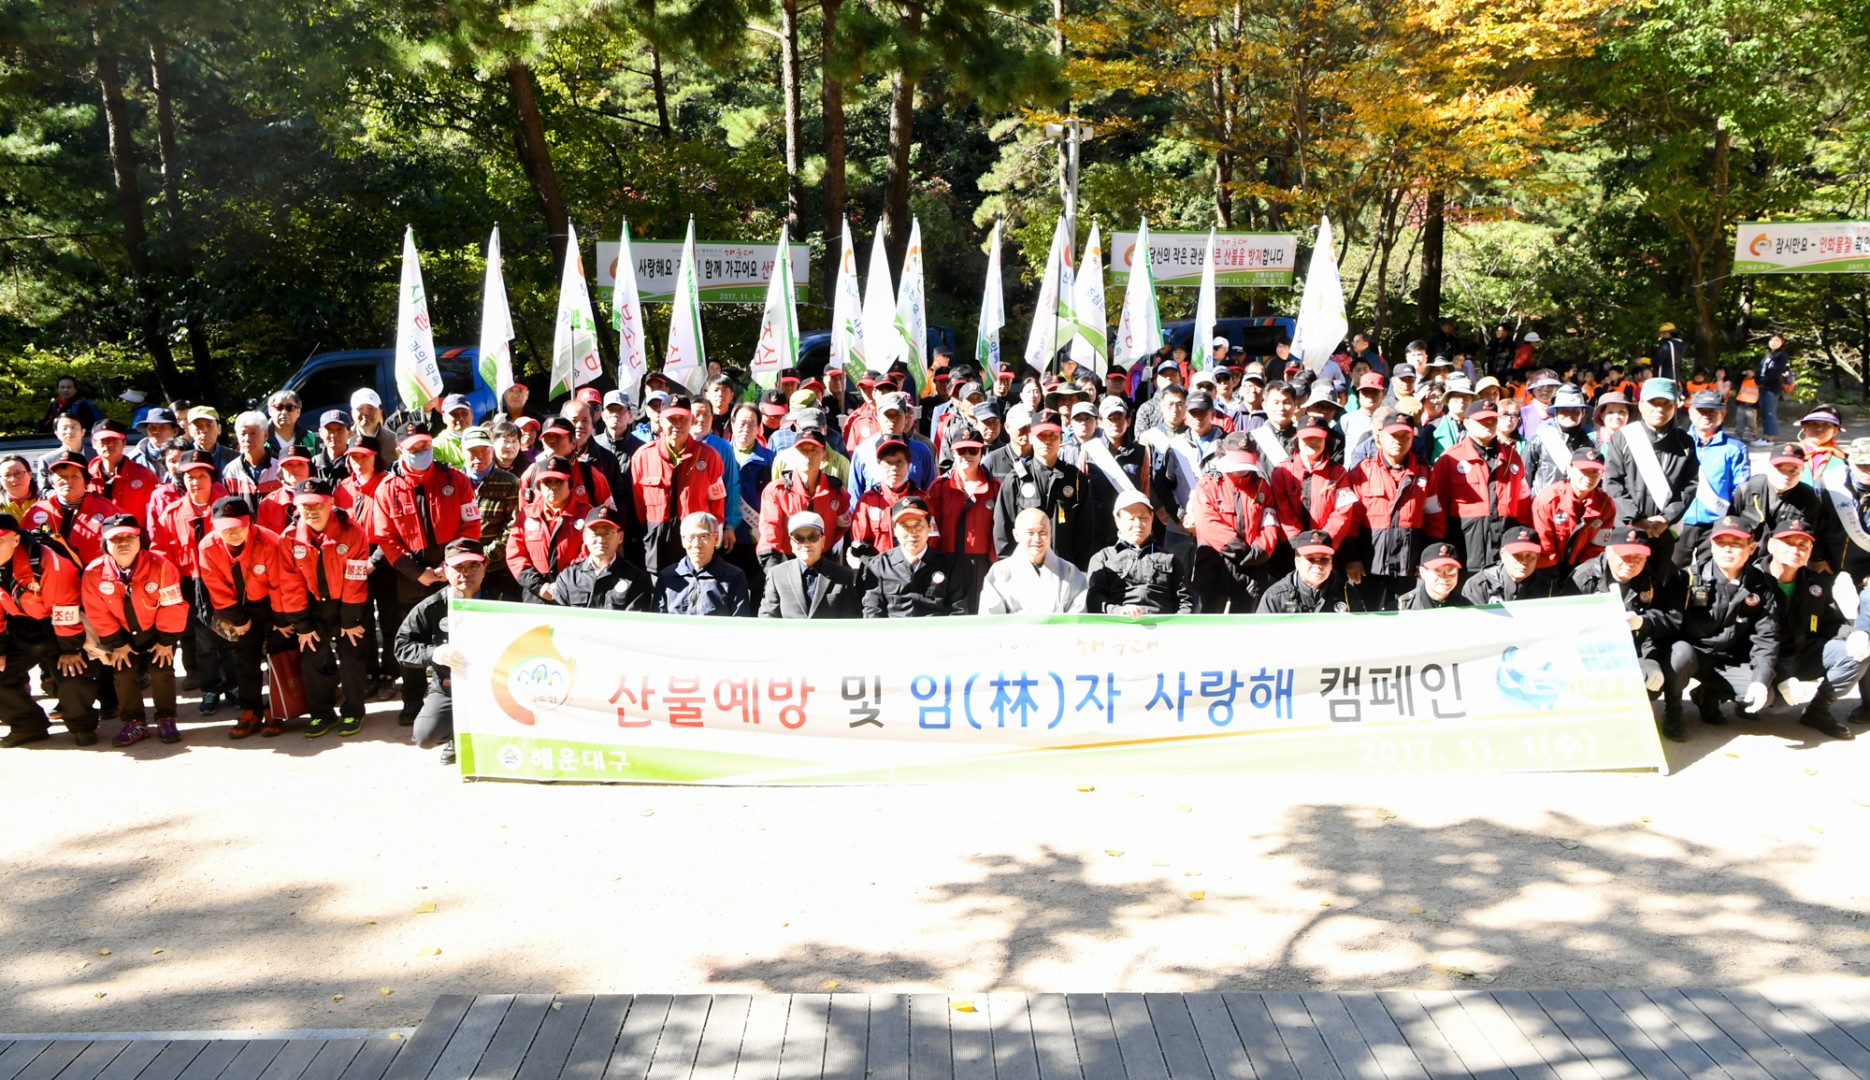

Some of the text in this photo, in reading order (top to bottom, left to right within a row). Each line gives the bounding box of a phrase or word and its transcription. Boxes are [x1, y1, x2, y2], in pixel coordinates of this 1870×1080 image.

[1173, 247, 1187, 265] 작은
[1190, 247, 1214, 265] 관심
[1214, 248, 1222, 265] 큰
[1224, 247, 1246, 266] 산불을
[1248, 247, 1284, 266] 방지합니다
[1776, 237, 1808, 255] 잠시만요
[1819, 236, 1852, 254] 인화물질
[639, 258, 673, 279] 사랑해요
[705, 259, 722, 279] 함께
[725, 259, 758, 279] 가꾸어요
[608, 662, 1468, 730] 산불예방 및 임(林)자 사랑해 캠페인
[531, 745, 631, 773] 해운대구
[1357, 730, 1597, 765] 2017. 11. 1(수)
